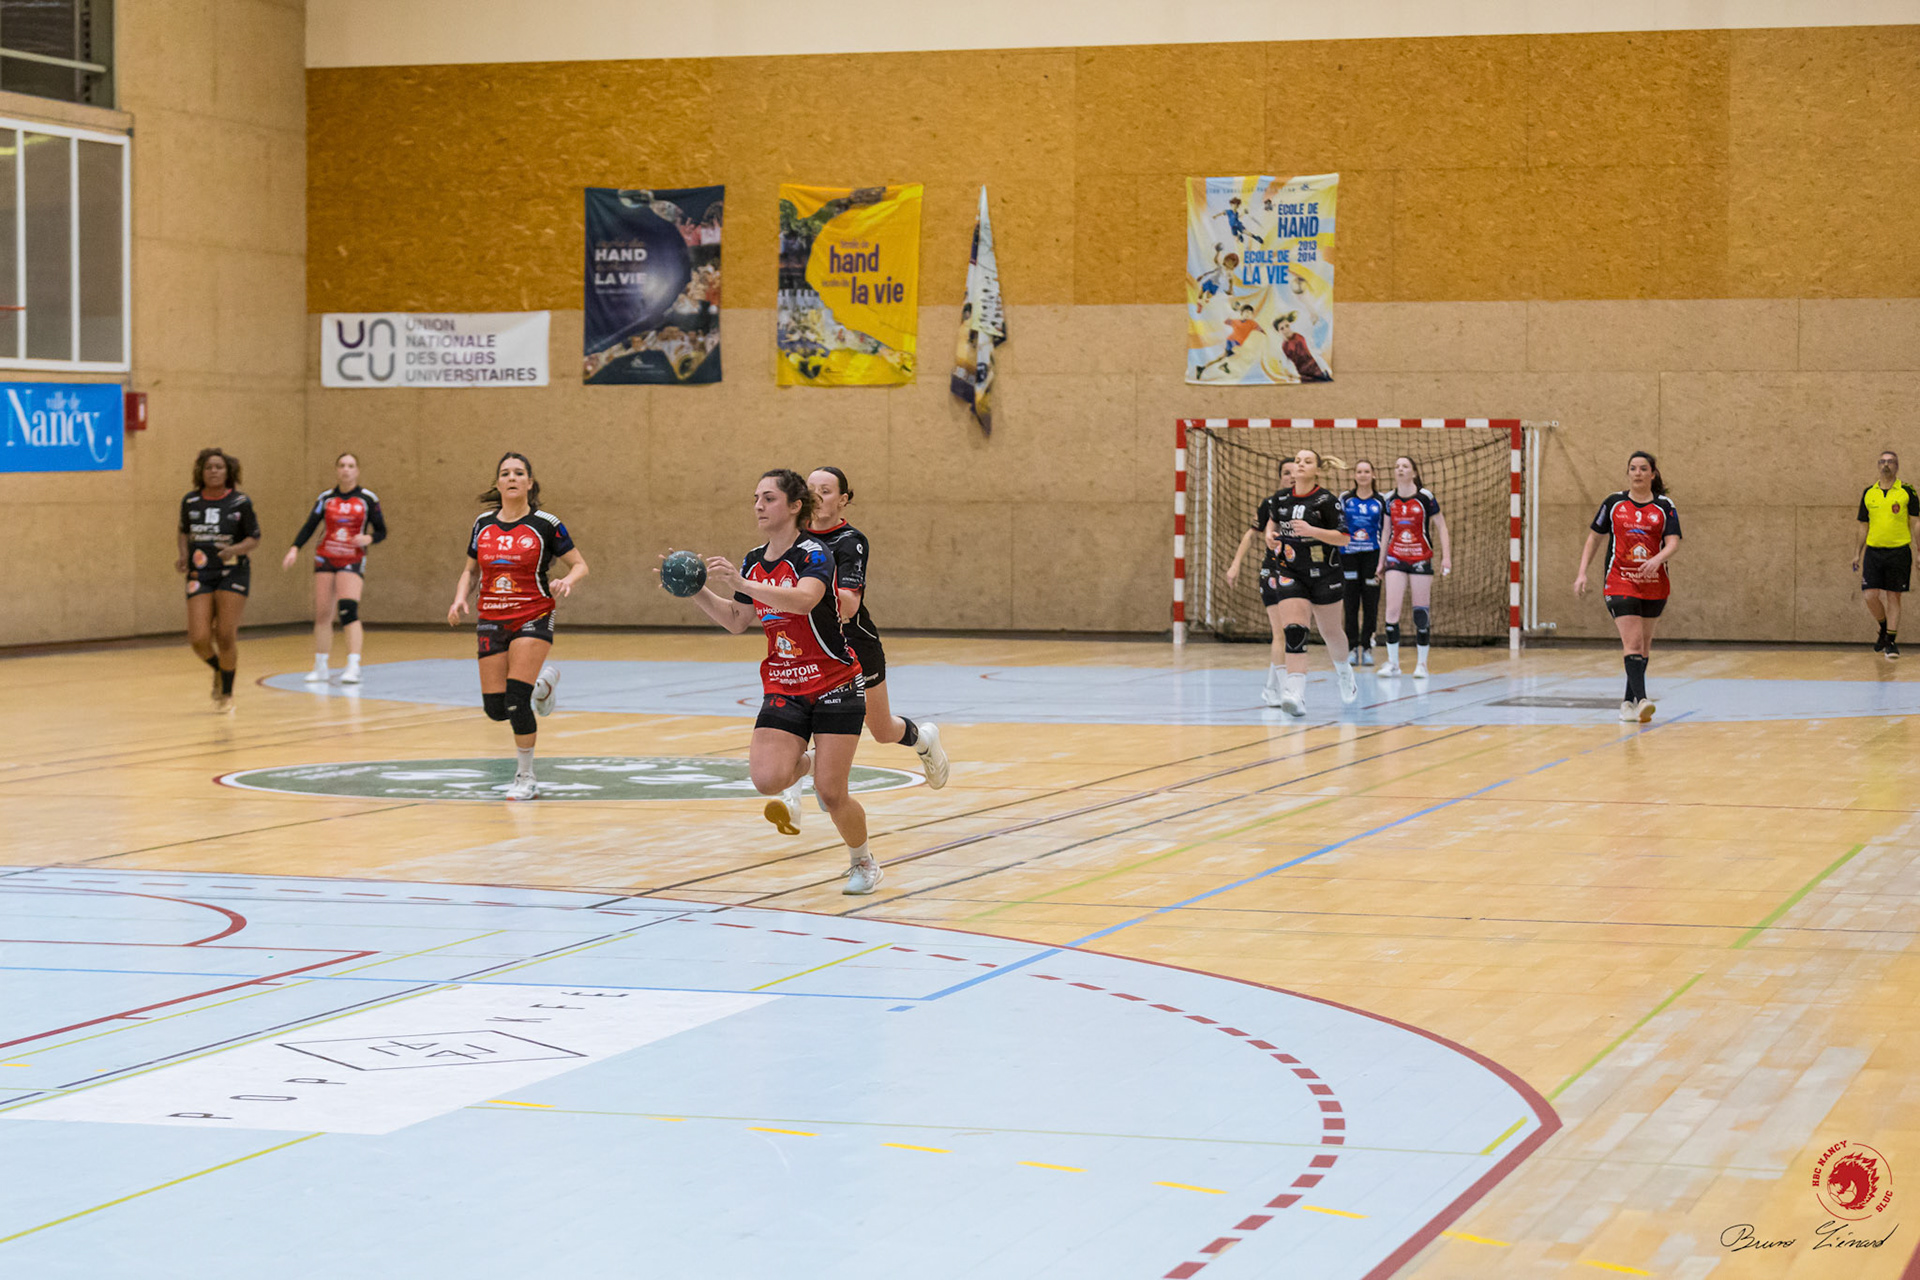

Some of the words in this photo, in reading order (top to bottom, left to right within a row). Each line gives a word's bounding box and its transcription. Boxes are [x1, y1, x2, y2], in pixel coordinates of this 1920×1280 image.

[1307, 202, 1319, 214] DE
[1278, 215, 1319, 238] HAND
[1298, 240, 1317, 251] 2013
[595, 248, 648, 262] HAND
[829, 243, 880, 274] hand
[1277, 250, 1290, 263] DE
[1297, 251, 1316, 262] 2014
[595, 272, 617, 286] LA
[618, 272, 647, 285] VIE
[1242, 265, 1261, 286] LA
[1266, 265, 1289, 284] VIE
[851, 275, 869, 306] la
[873, 275, 904, 304] vie
[405, 318, 455, 331] UNION
[405, 334, 496, 348] NATIONALE
[405, 351, 437, 365] DES
[441, 351, 496, 364] CLUBS
[405, 367, 537, 382] UNIVERSITAIRES
[6, 388, 113, 464] Nancy
[205, 507, 220, 524] 15
[1292, 504, 1306, 520] 19
[1635, 510, 1643, 523] 9
[496, 535, 514, 550] 13
